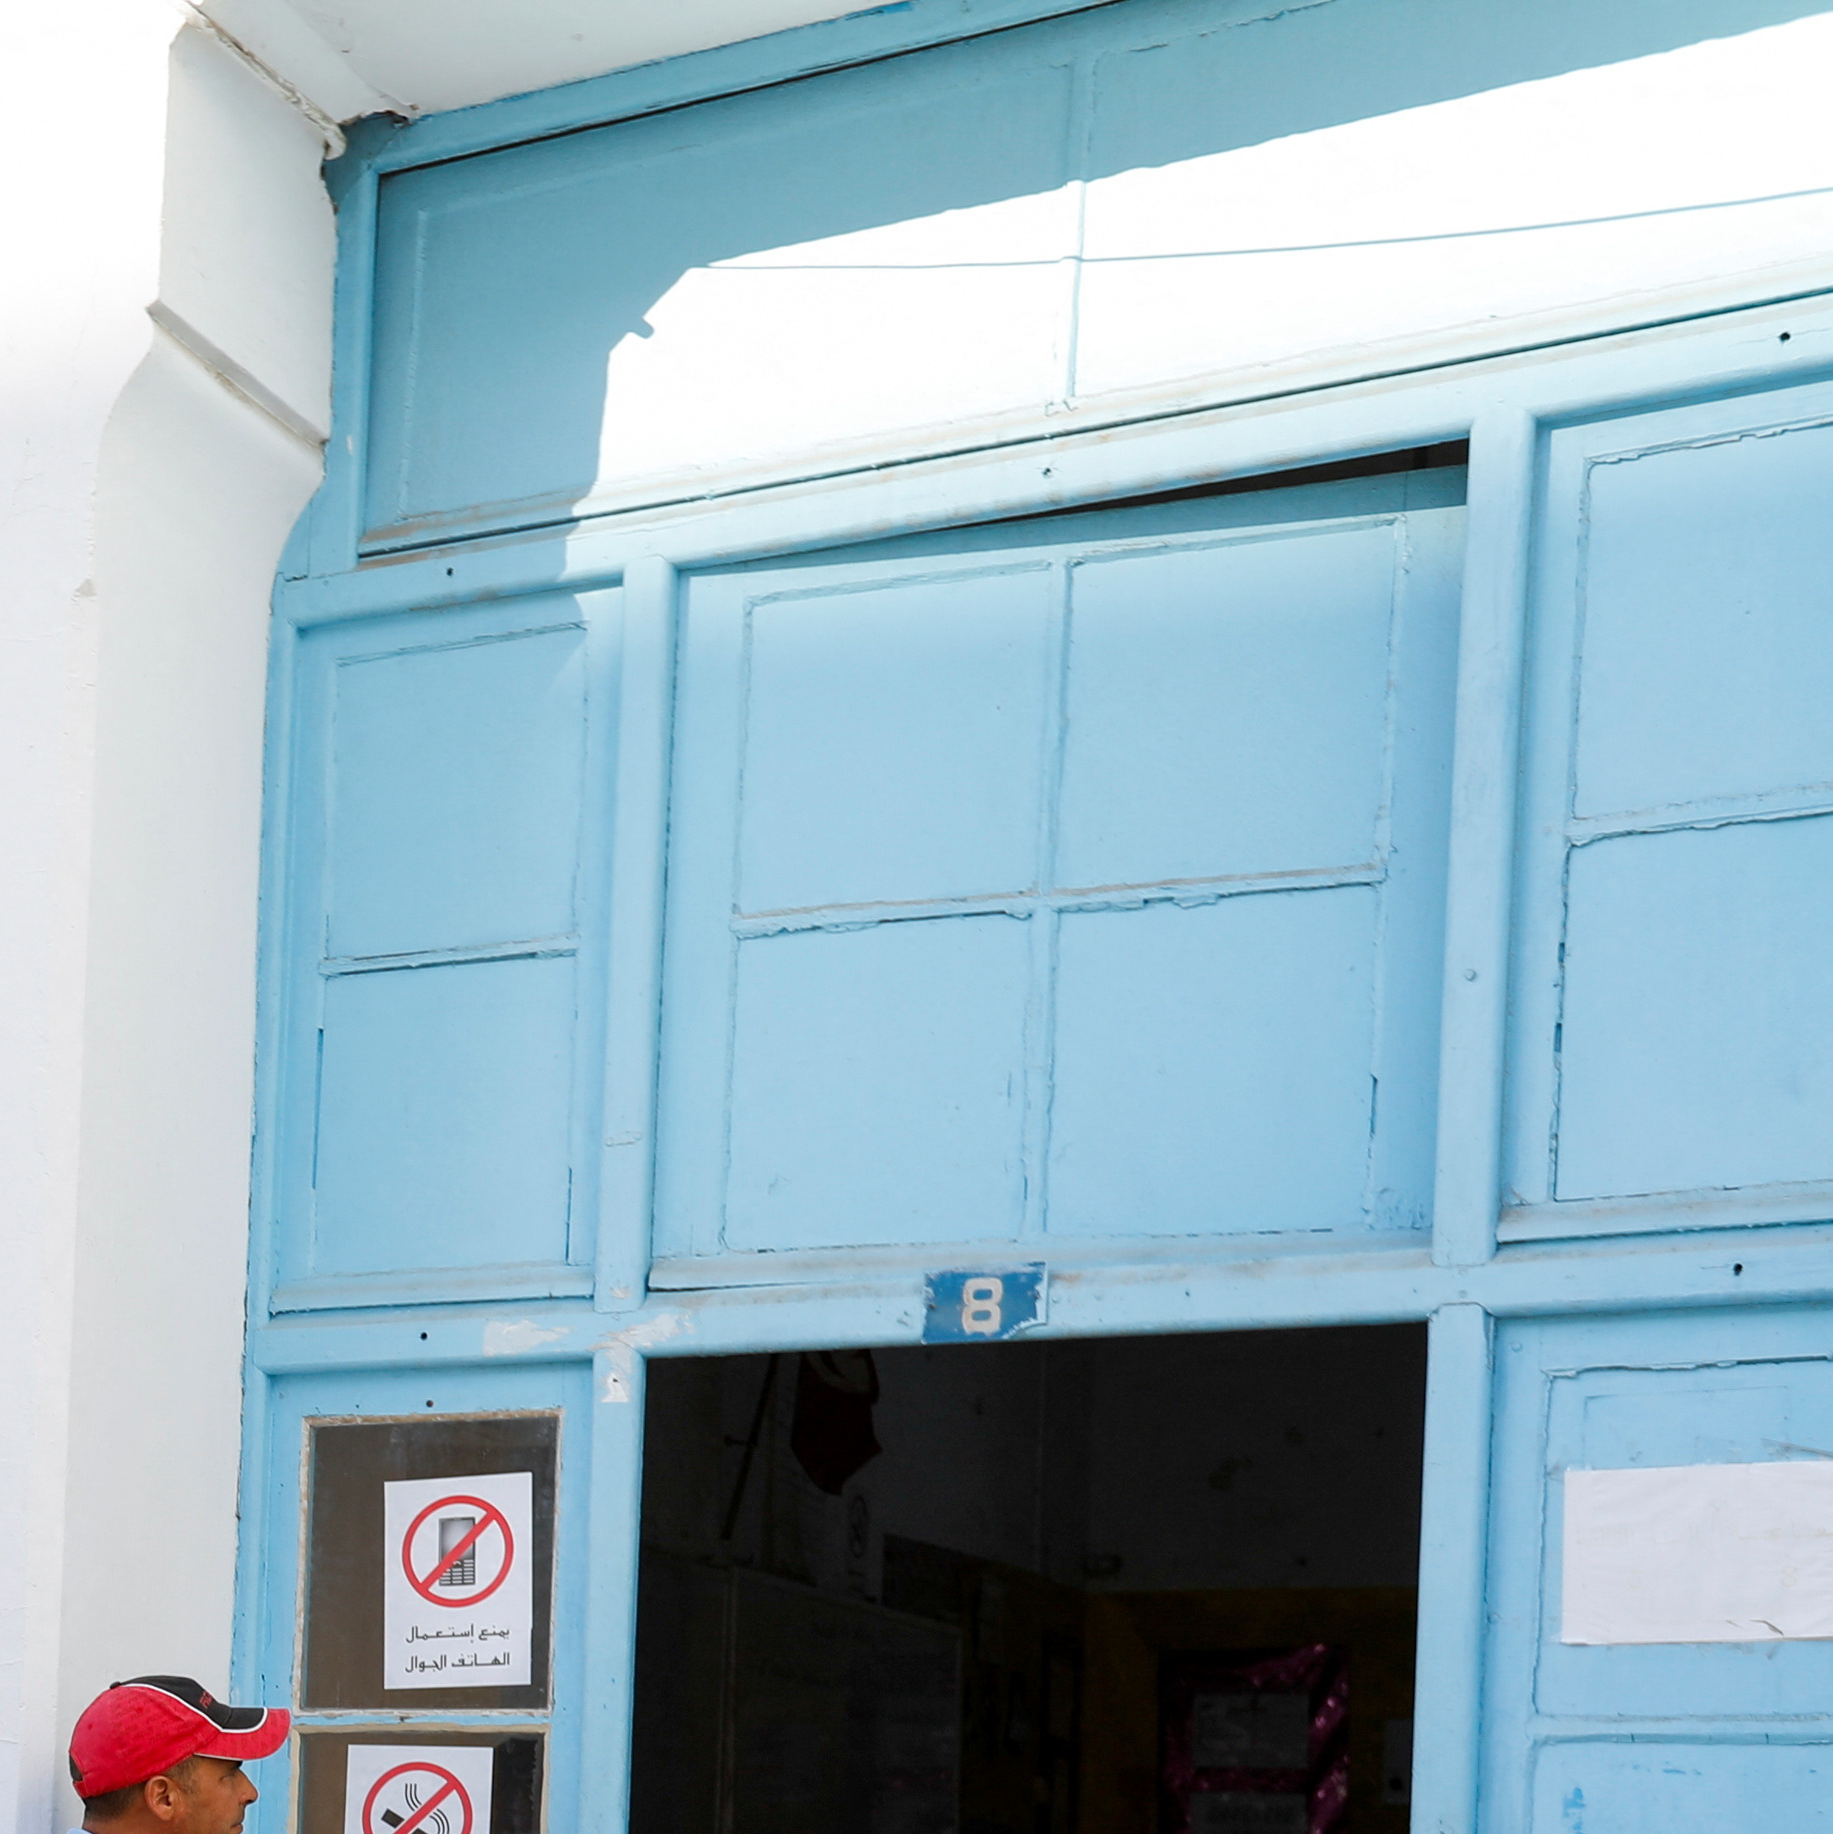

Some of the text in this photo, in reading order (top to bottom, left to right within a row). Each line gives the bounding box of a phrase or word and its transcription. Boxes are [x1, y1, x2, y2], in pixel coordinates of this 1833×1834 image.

[962, 1276, 1003, 1336] 8
[478, 1624, 510, 1641] يمنع
[405, 1651, 510, 1673] الهاتف الجوال
